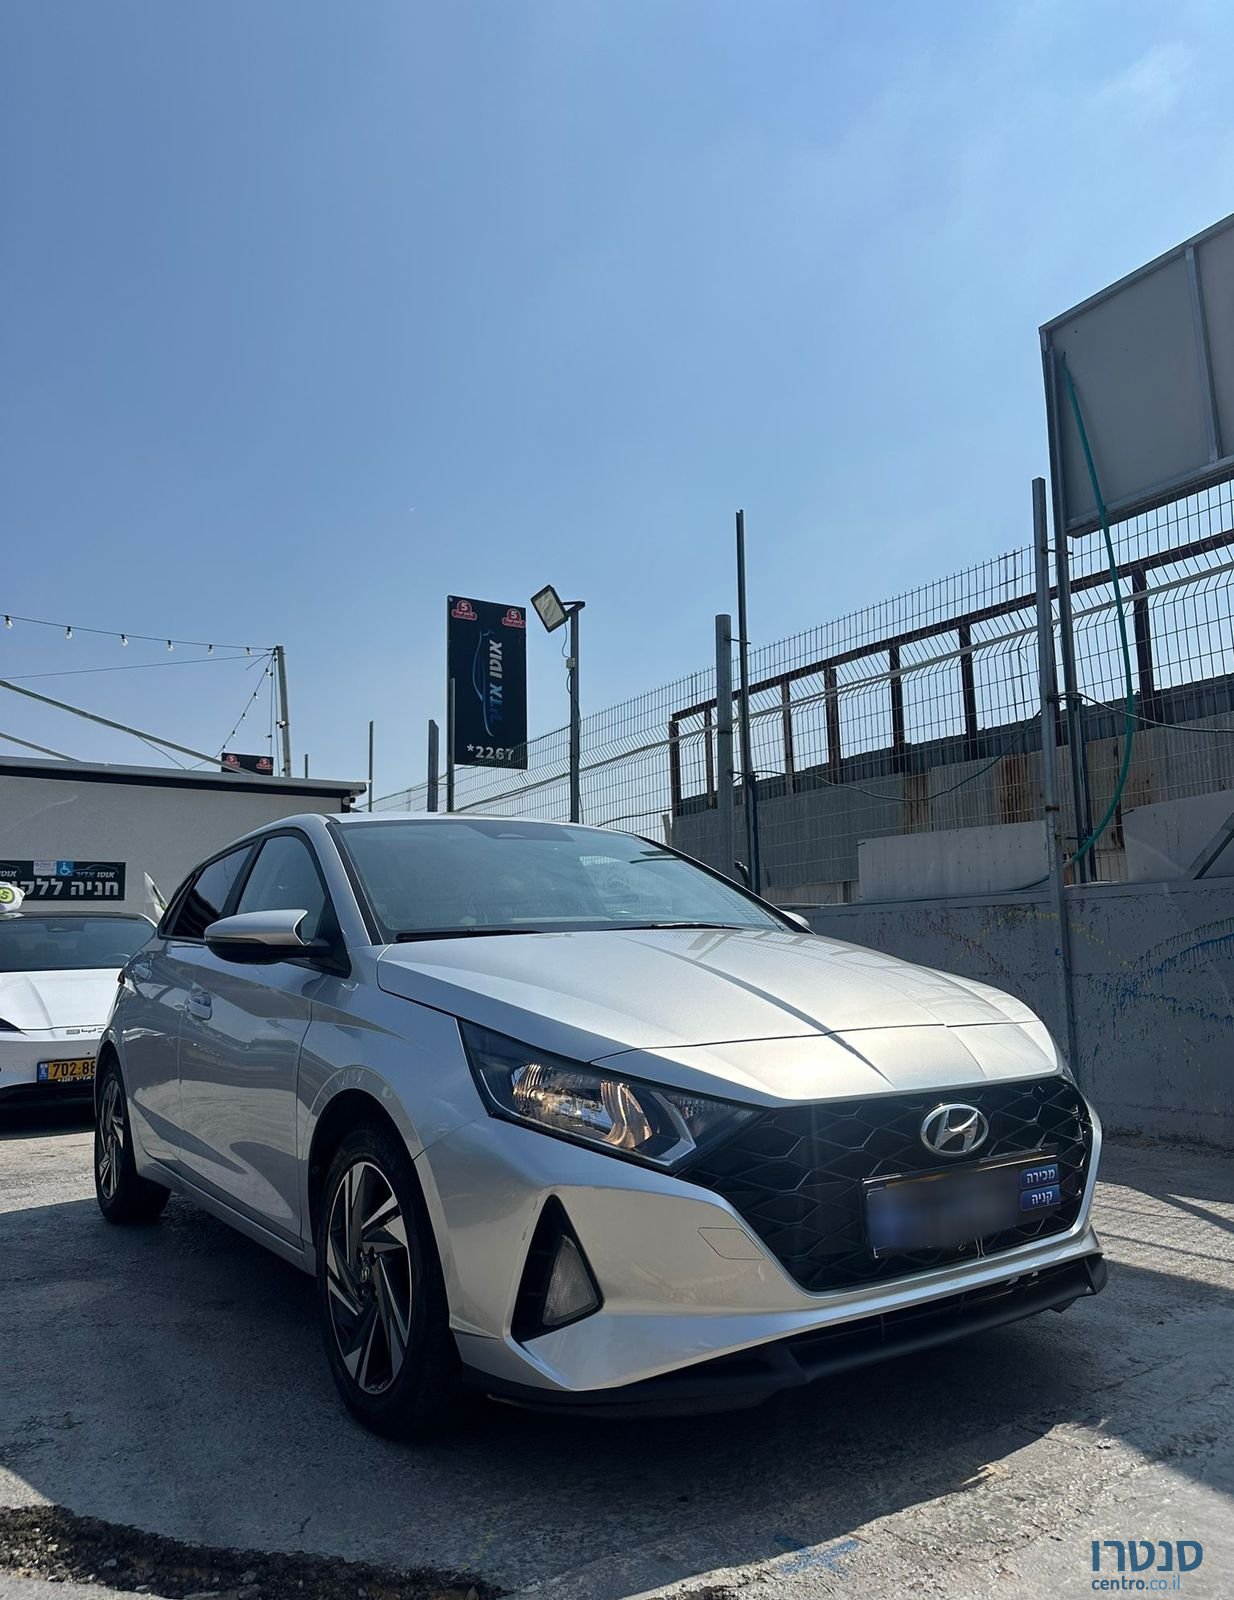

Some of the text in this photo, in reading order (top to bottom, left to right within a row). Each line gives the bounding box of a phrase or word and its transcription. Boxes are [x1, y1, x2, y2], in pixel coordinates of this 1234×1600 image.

[489, 639, 503, 679] אוטו
[70, 881, 119, 896] חניה
[1026, 1169, 1056, 1184] מכירה
[1031, 1191, 1053, 1205] קניה
